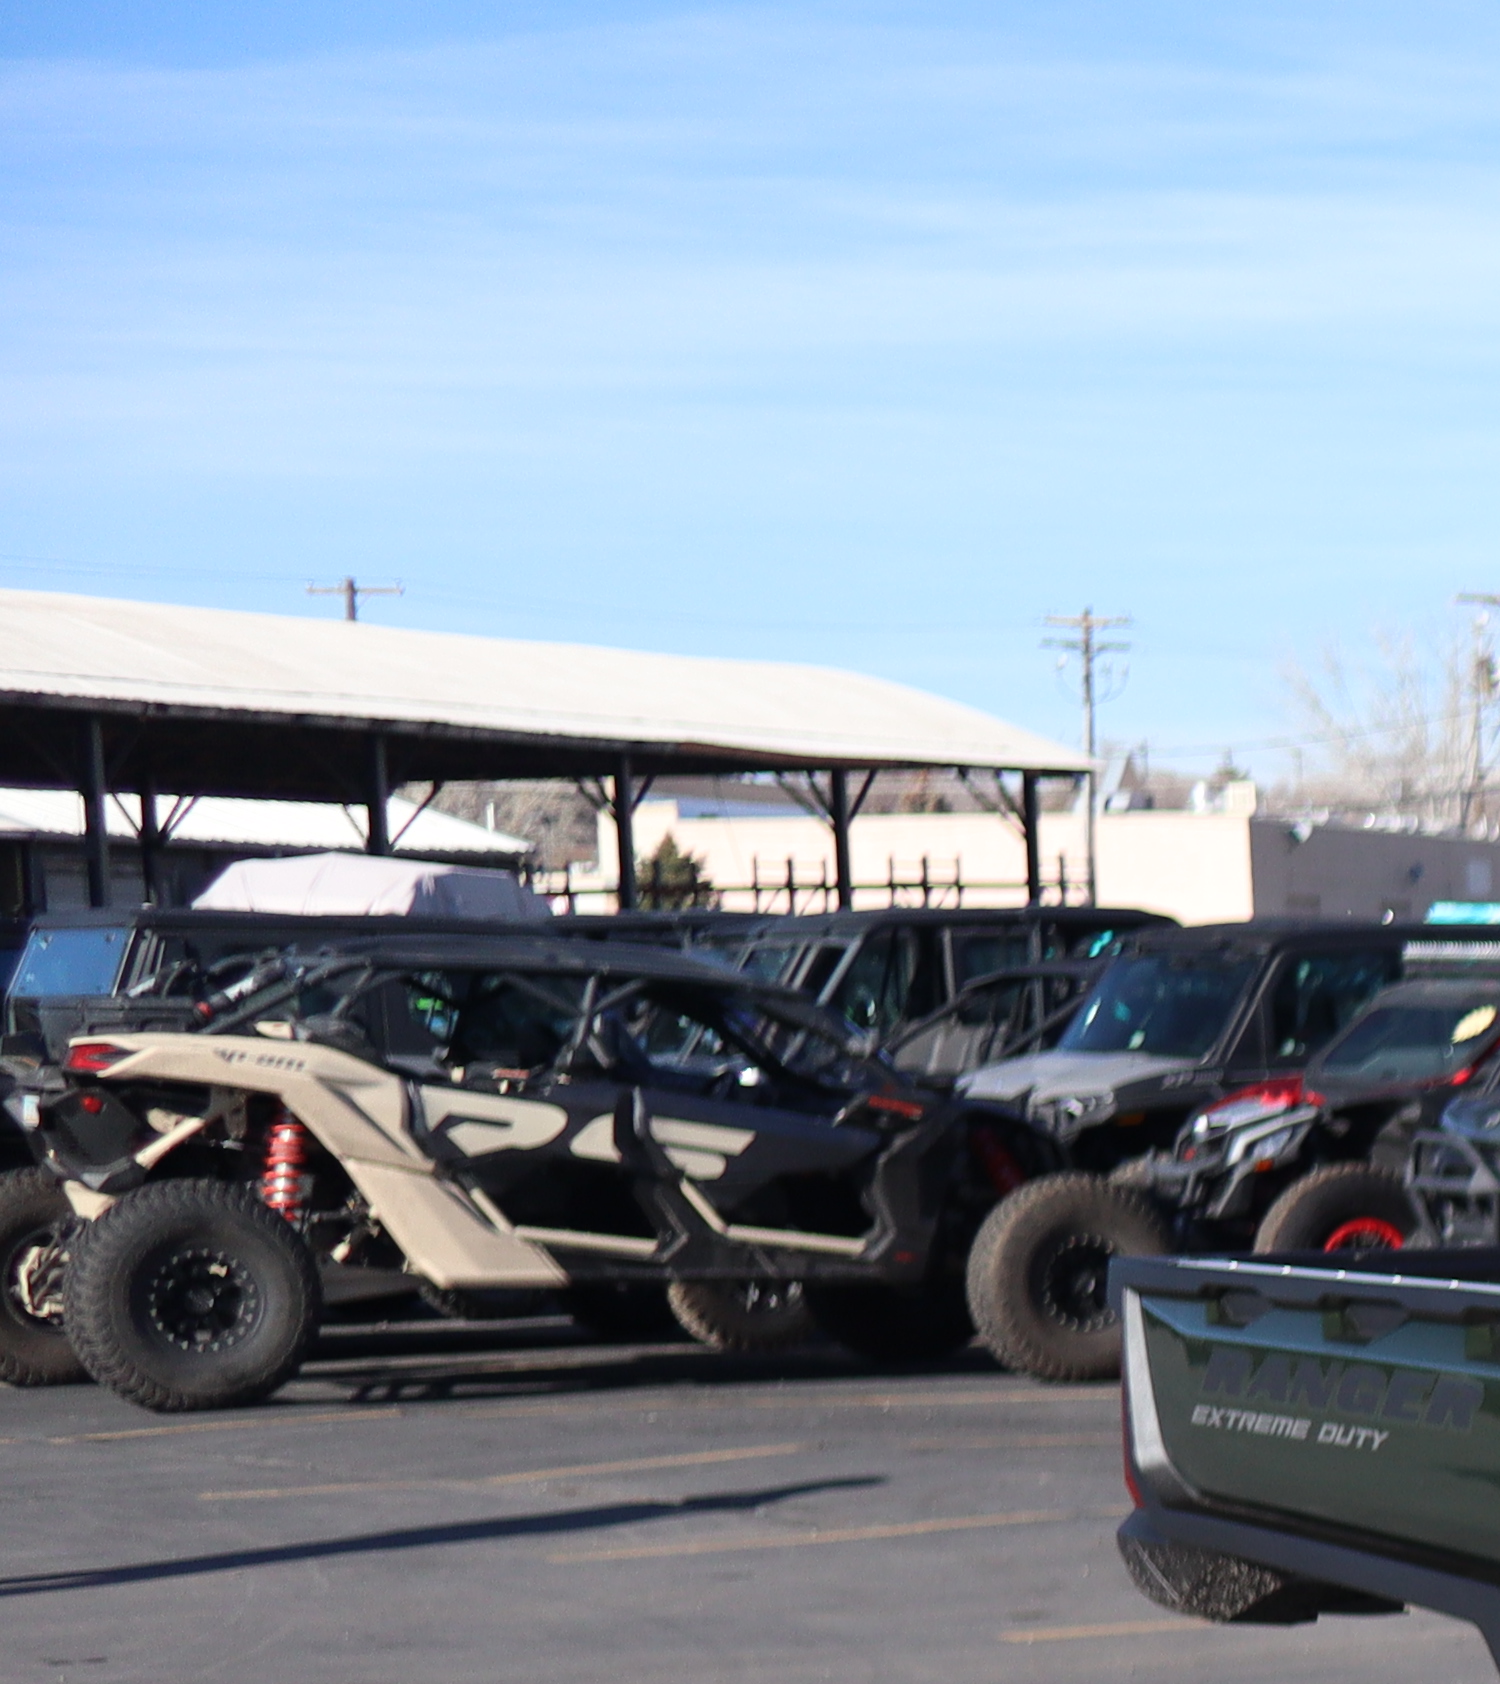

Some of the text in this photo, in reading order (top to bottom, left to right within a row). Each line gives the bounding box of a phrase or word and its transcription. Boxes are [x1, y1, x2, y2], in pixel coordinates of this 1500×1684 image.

[1201, 1344, 1485, 1433] RANGER
[1191, 1404, 1390, 1451] EXTREME DUTY
